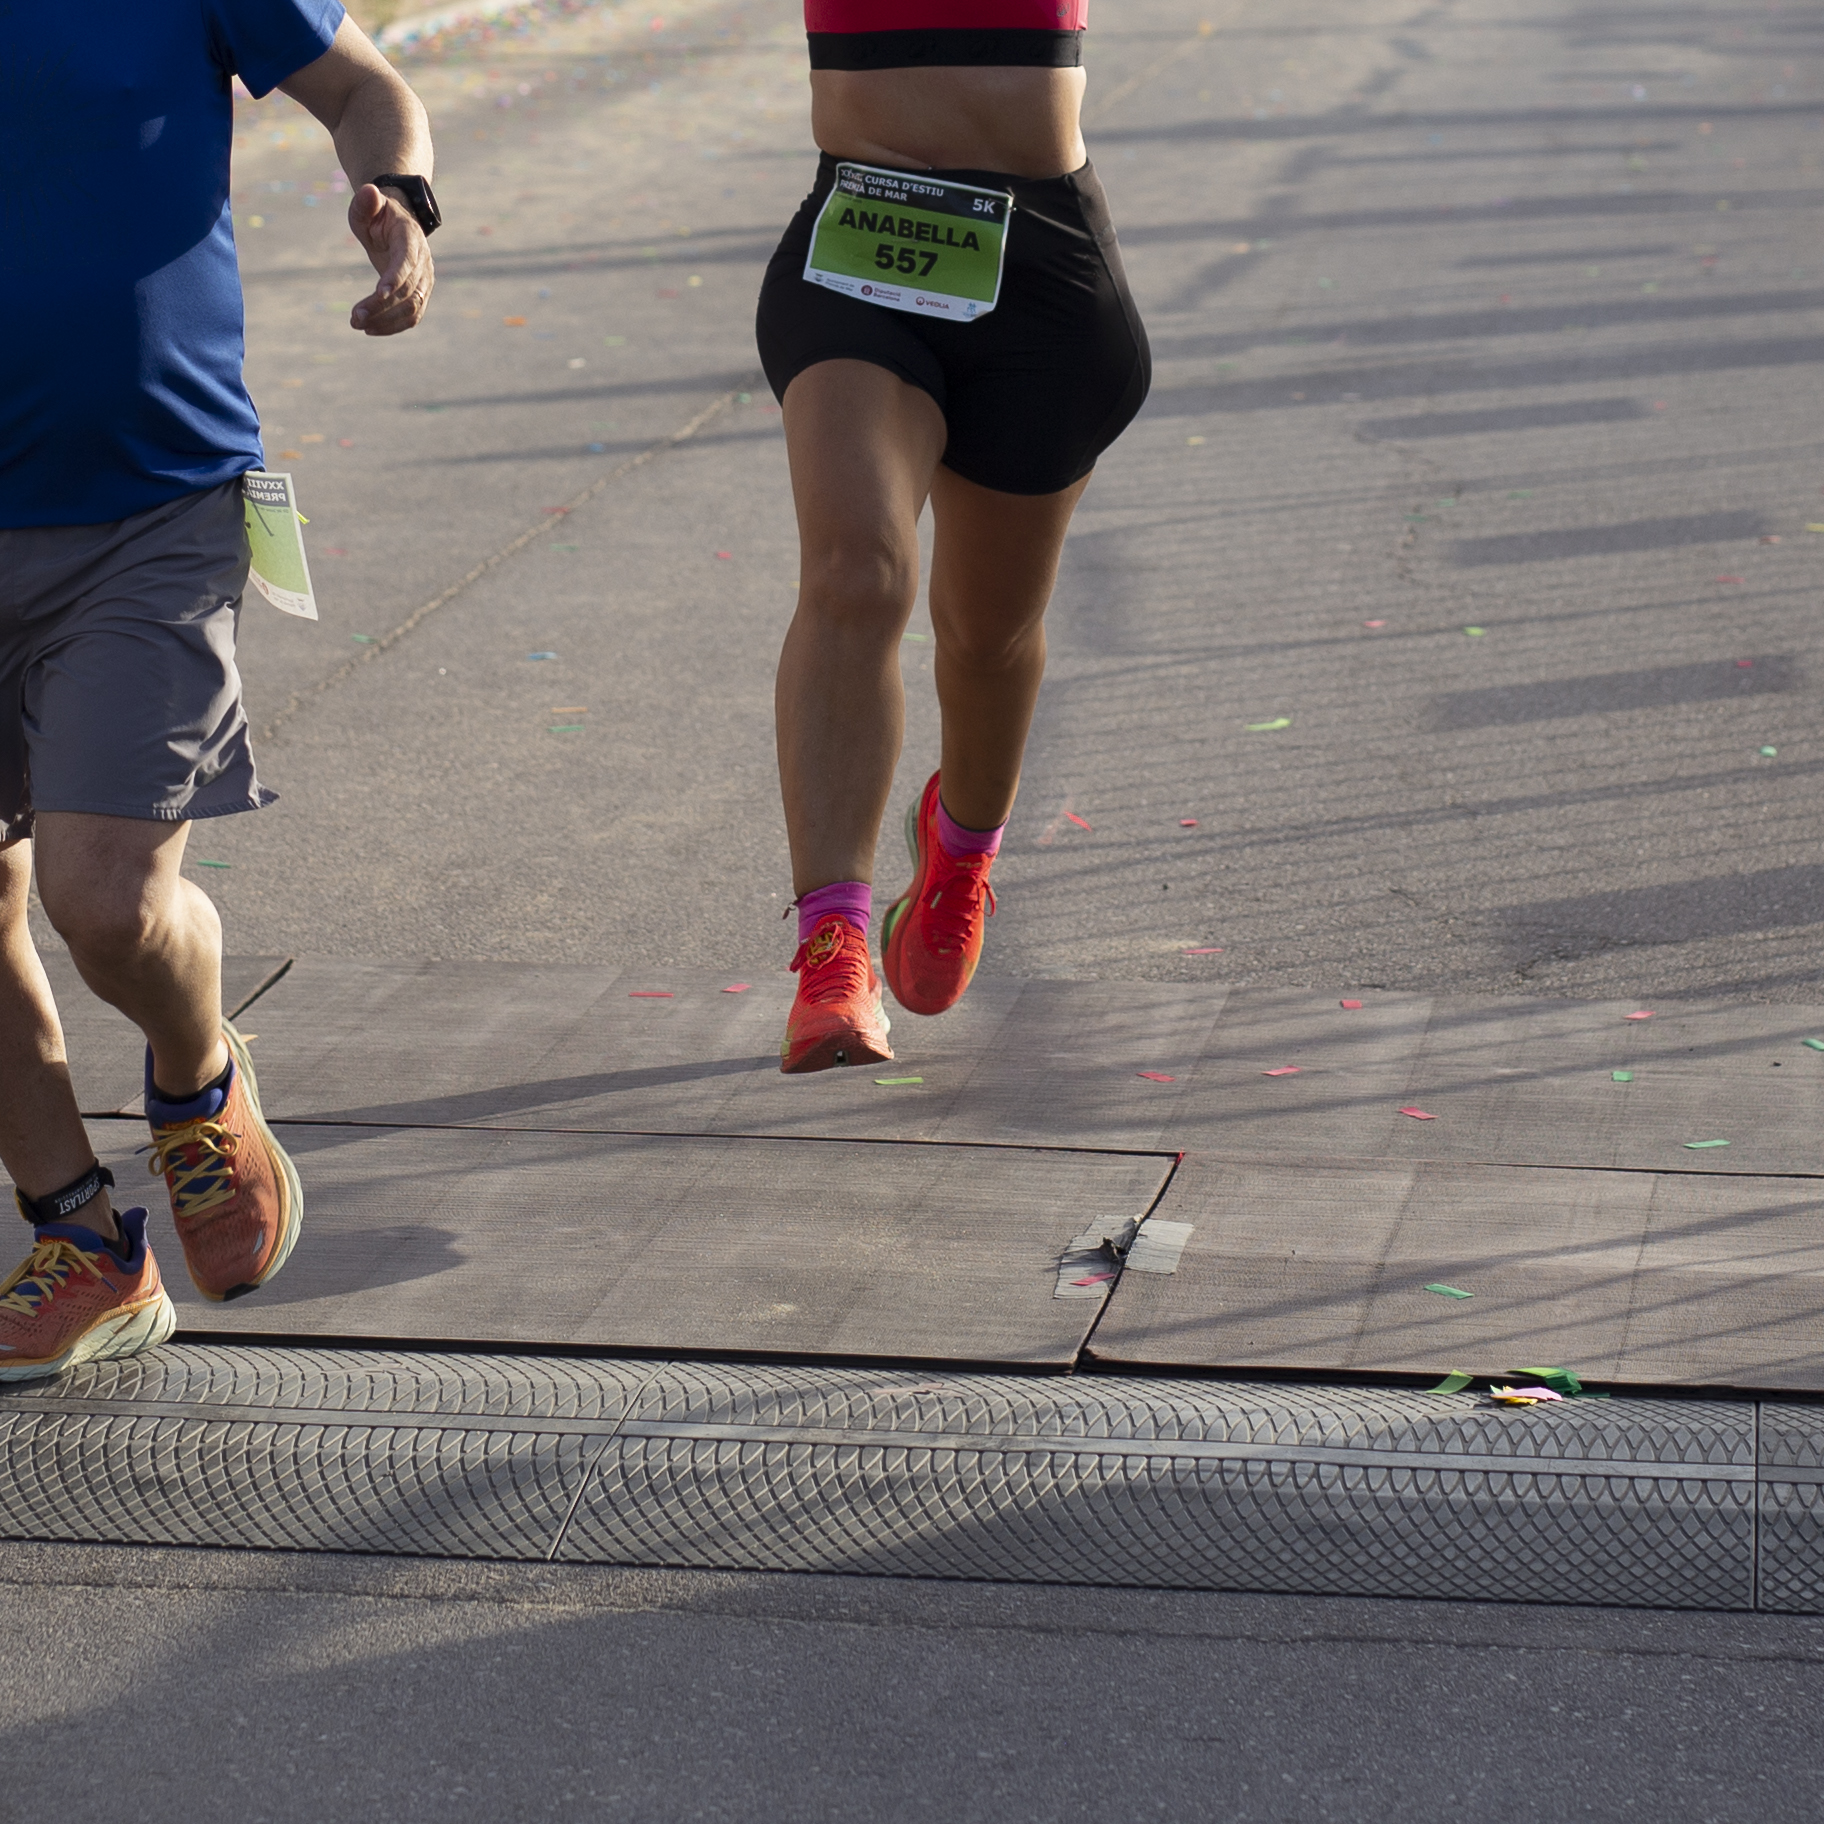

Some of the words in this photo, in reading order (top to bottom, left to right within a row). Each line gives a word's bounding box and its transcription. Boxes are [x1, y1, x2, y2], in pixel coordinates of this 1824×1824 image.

[865, 174, 899, 189] CURSA
[902, 181, 945, 197] D'ESTIU
[868, 186, 882, 196] DE
[884, 189, 908, 201] MAR
[972, 197, 996, 214] 5K
[838, 207, 981, 252] ANABELLA
[874, 243, 939, 277] 557
[59, 1176, 100, 1215] SPORTLAST
